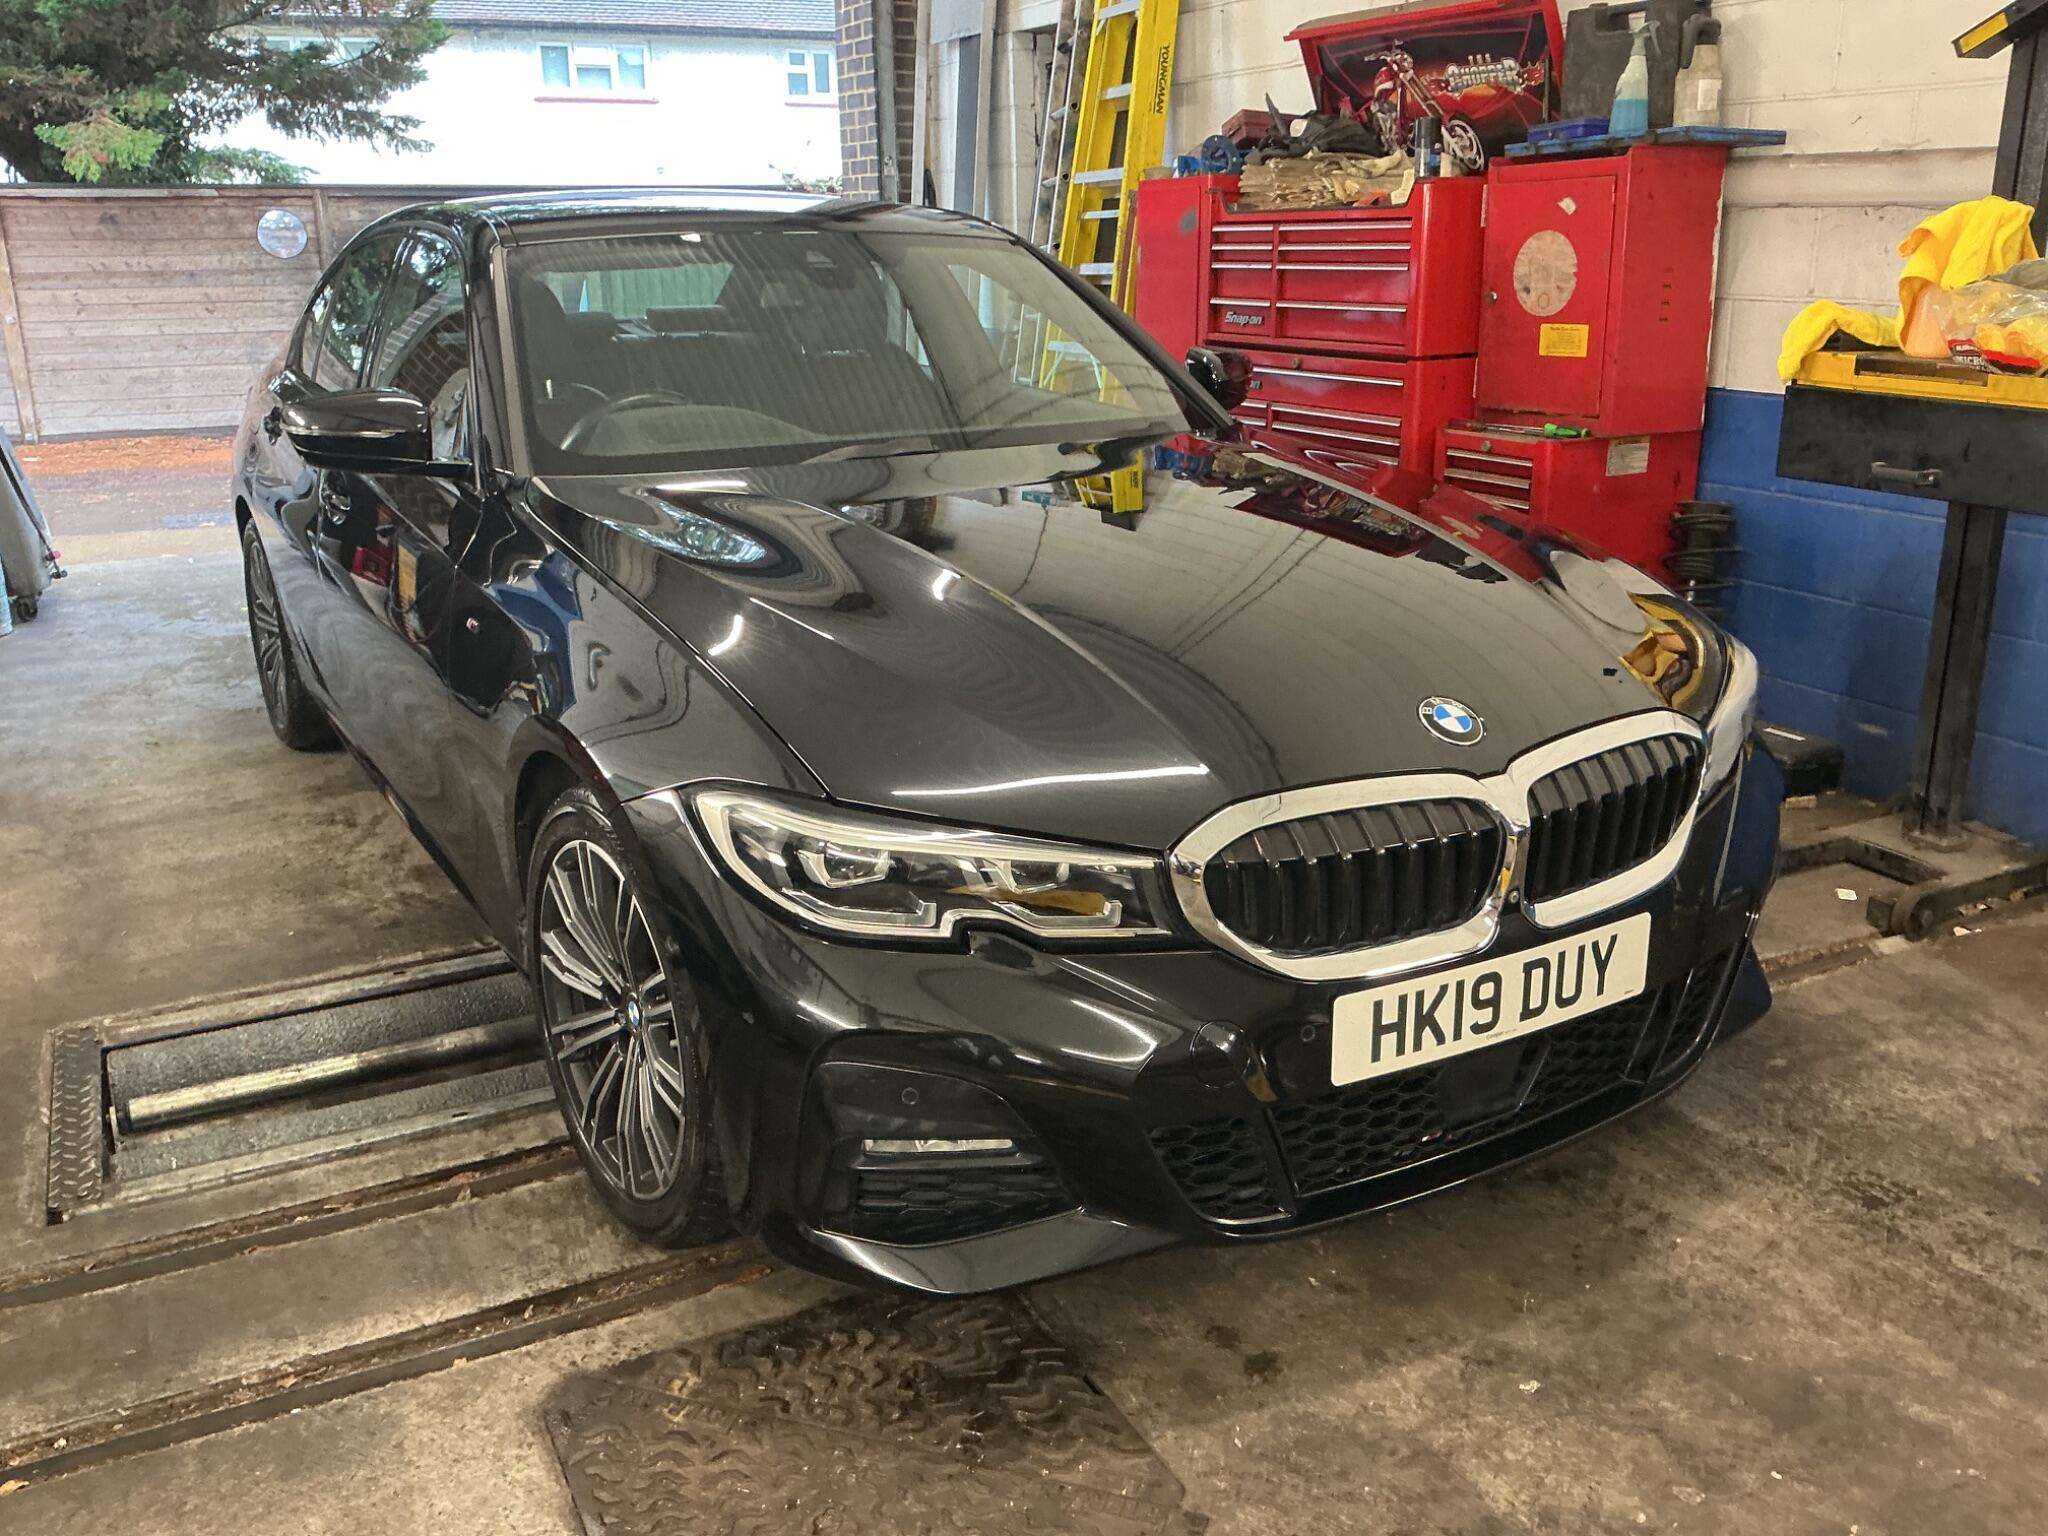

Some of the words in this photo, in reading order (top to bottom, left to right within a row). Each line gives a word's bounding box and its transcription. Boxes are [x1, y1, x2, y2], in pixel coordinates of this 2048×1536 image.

[1156, 44, 1170, 114] YOUNGMAN
[1225, 311, 1263, 326] Snap-on
[1371, 971, 1502, 1063] HK19
[1519, 934, 1618, 1022] DUY
